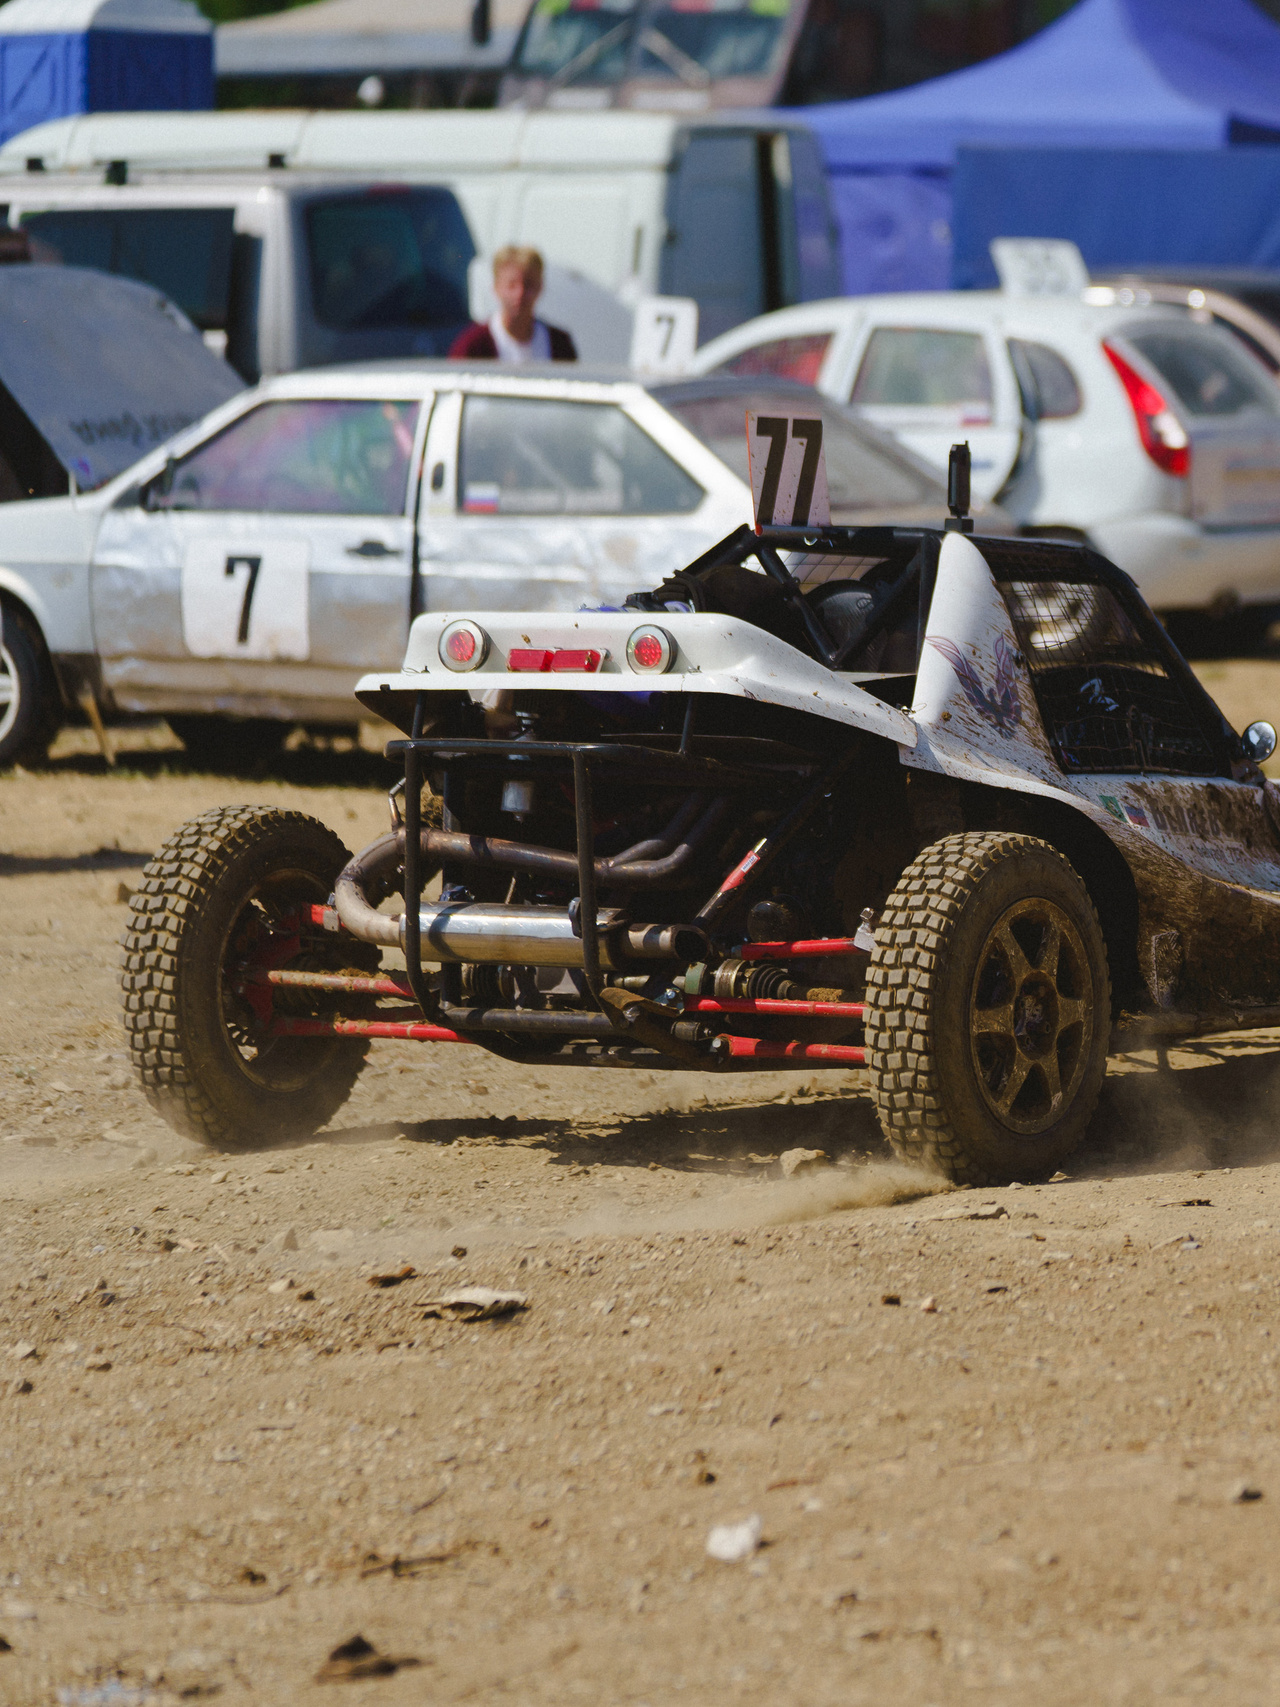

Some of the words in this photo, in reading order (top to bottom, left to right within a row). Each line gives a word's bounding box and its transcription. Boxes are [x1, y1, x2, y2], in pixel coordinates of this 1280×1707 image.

[655, 314, 675, 358] 7
[756, 416, 823, 527] 77
[225, 556, 262, 643] 7
